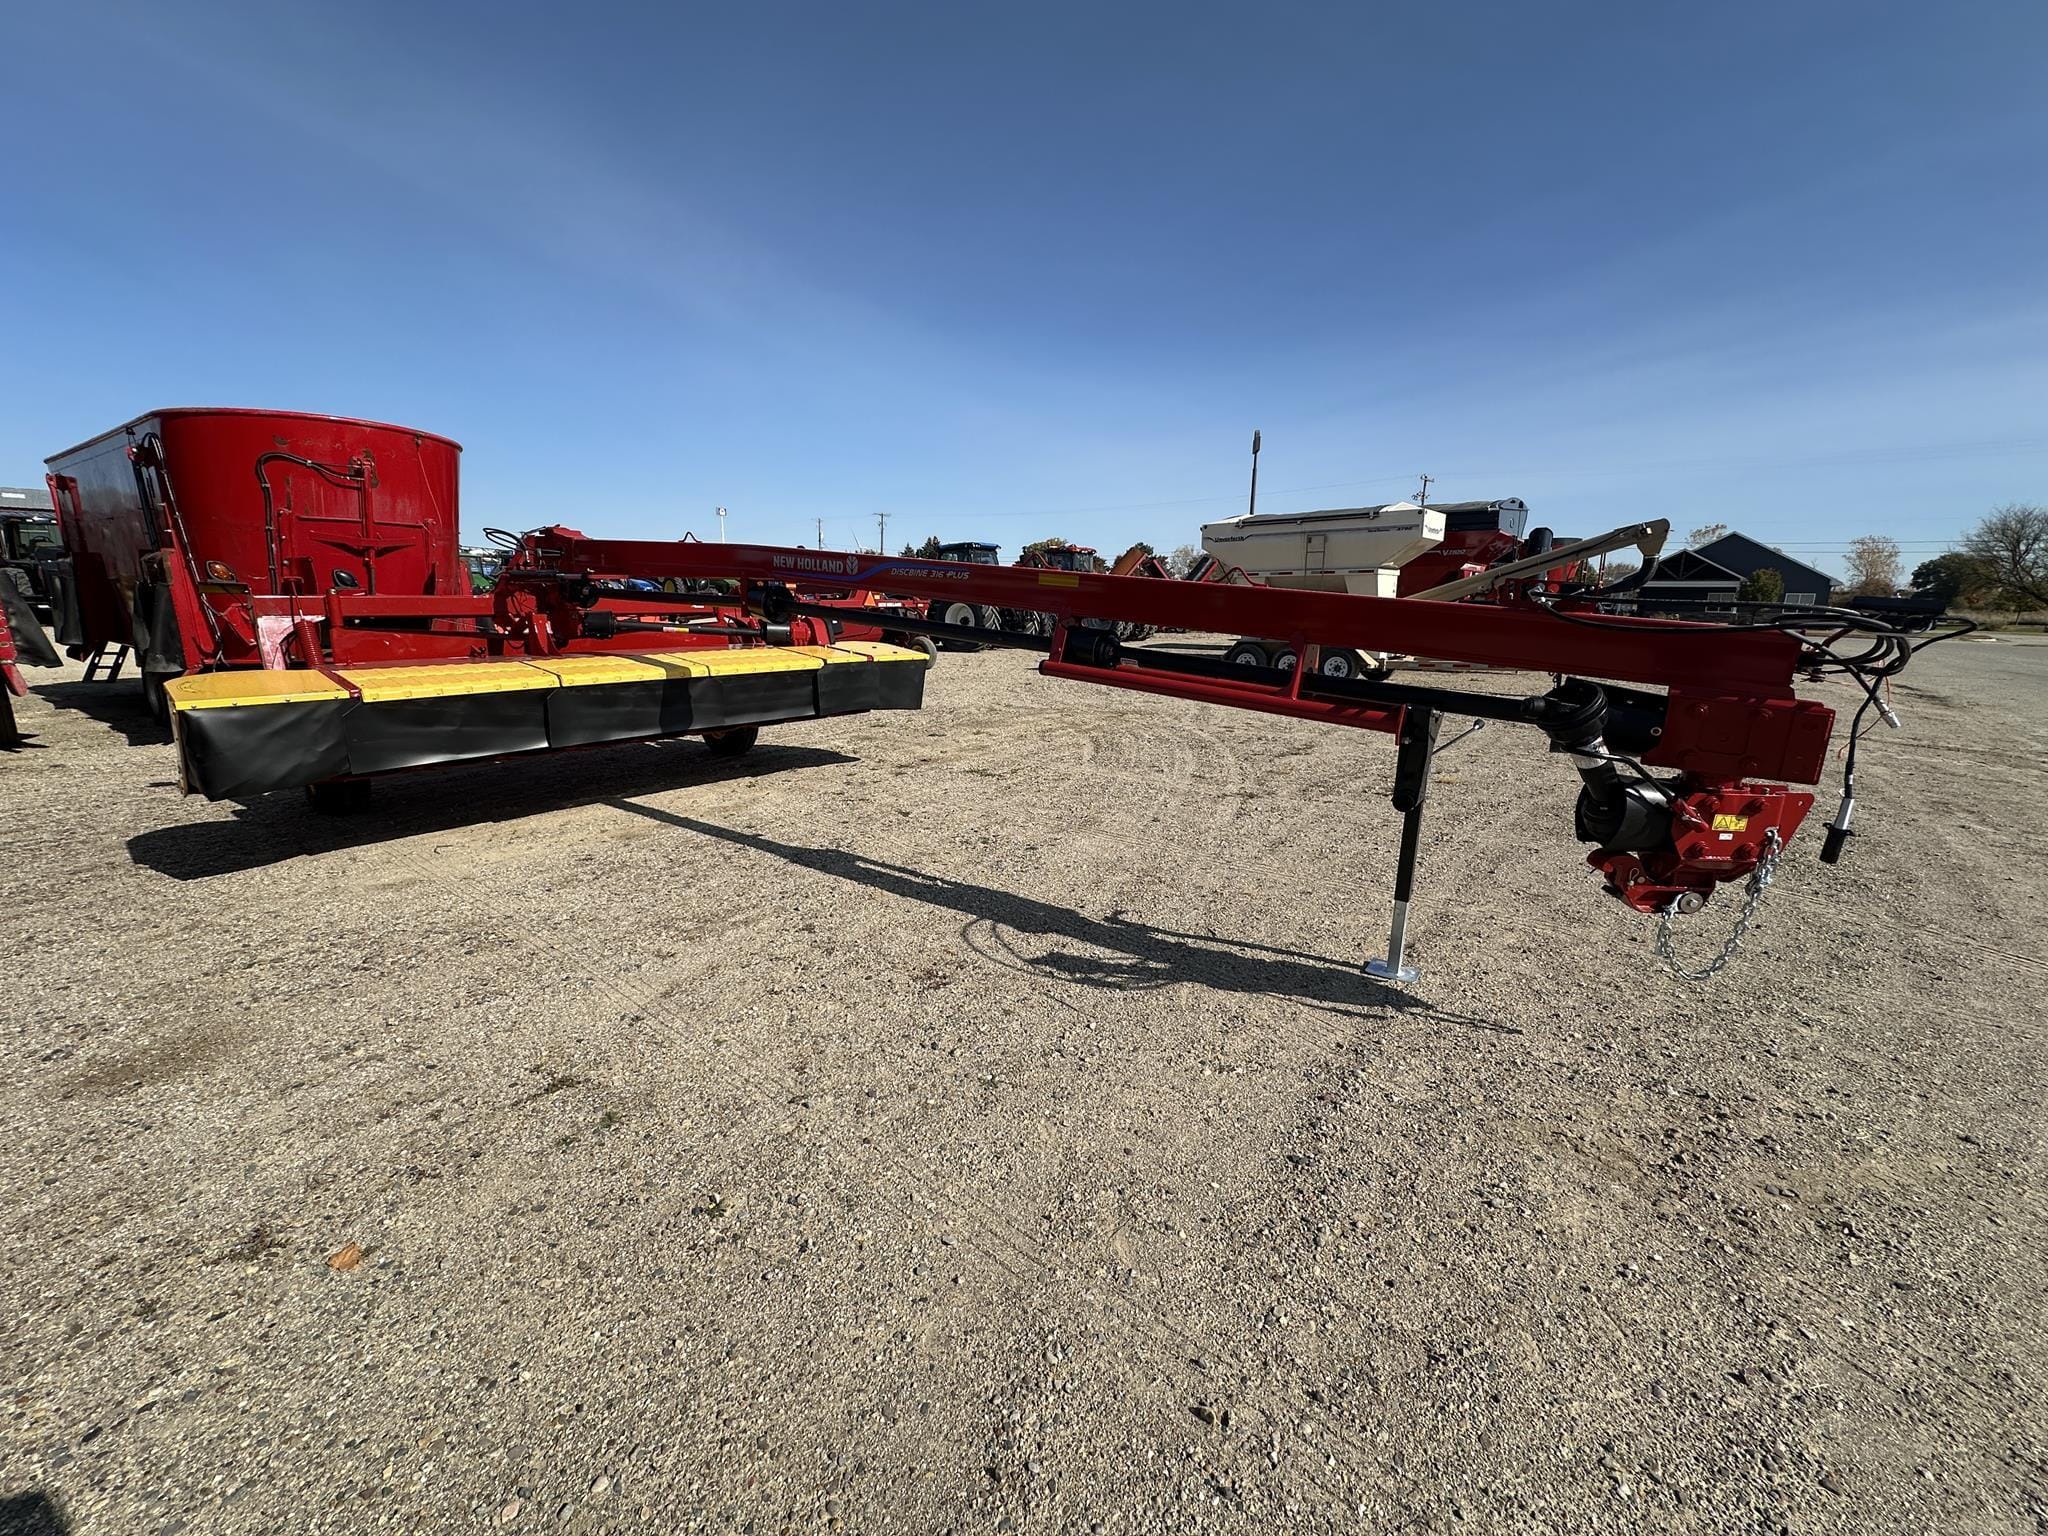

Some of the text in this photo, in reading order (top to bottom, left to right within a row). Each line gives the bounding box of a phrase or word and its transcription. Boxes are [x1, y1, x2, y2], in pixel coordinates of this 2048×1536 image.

[773, 555, 844, 573] NEW HOLLAND
[891, 568, 970, 580] DISCBINE 316 PLUS
